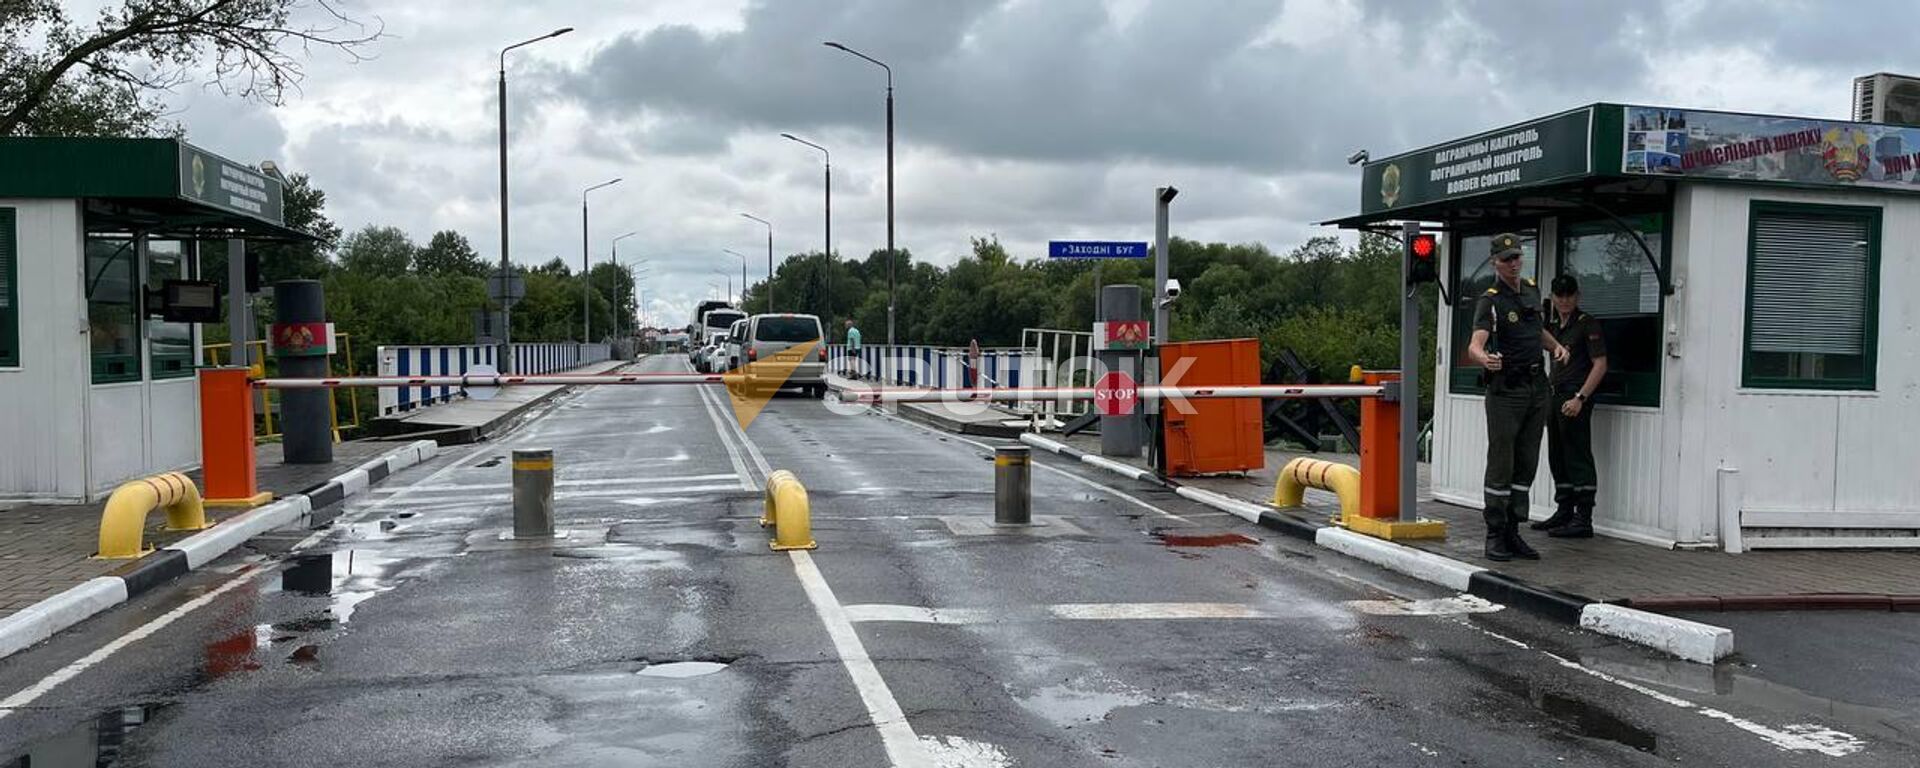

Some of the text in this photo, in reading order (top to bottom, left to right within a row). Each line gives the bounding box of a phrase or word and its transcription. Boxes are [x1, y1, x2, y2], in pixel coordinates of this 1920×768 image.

[1490, 129, 1539, 152] КАНТРОЛЬ
[1430, 145, 1543, 181] ПОГРАНИЧНЫЙ КОНТРОЛЬ
[1447, 168, 1520, 194] BORDER CONTROL
[1116, 246, 1134, 254] БУГ
[1097, 389, 1135, 400] STOP
